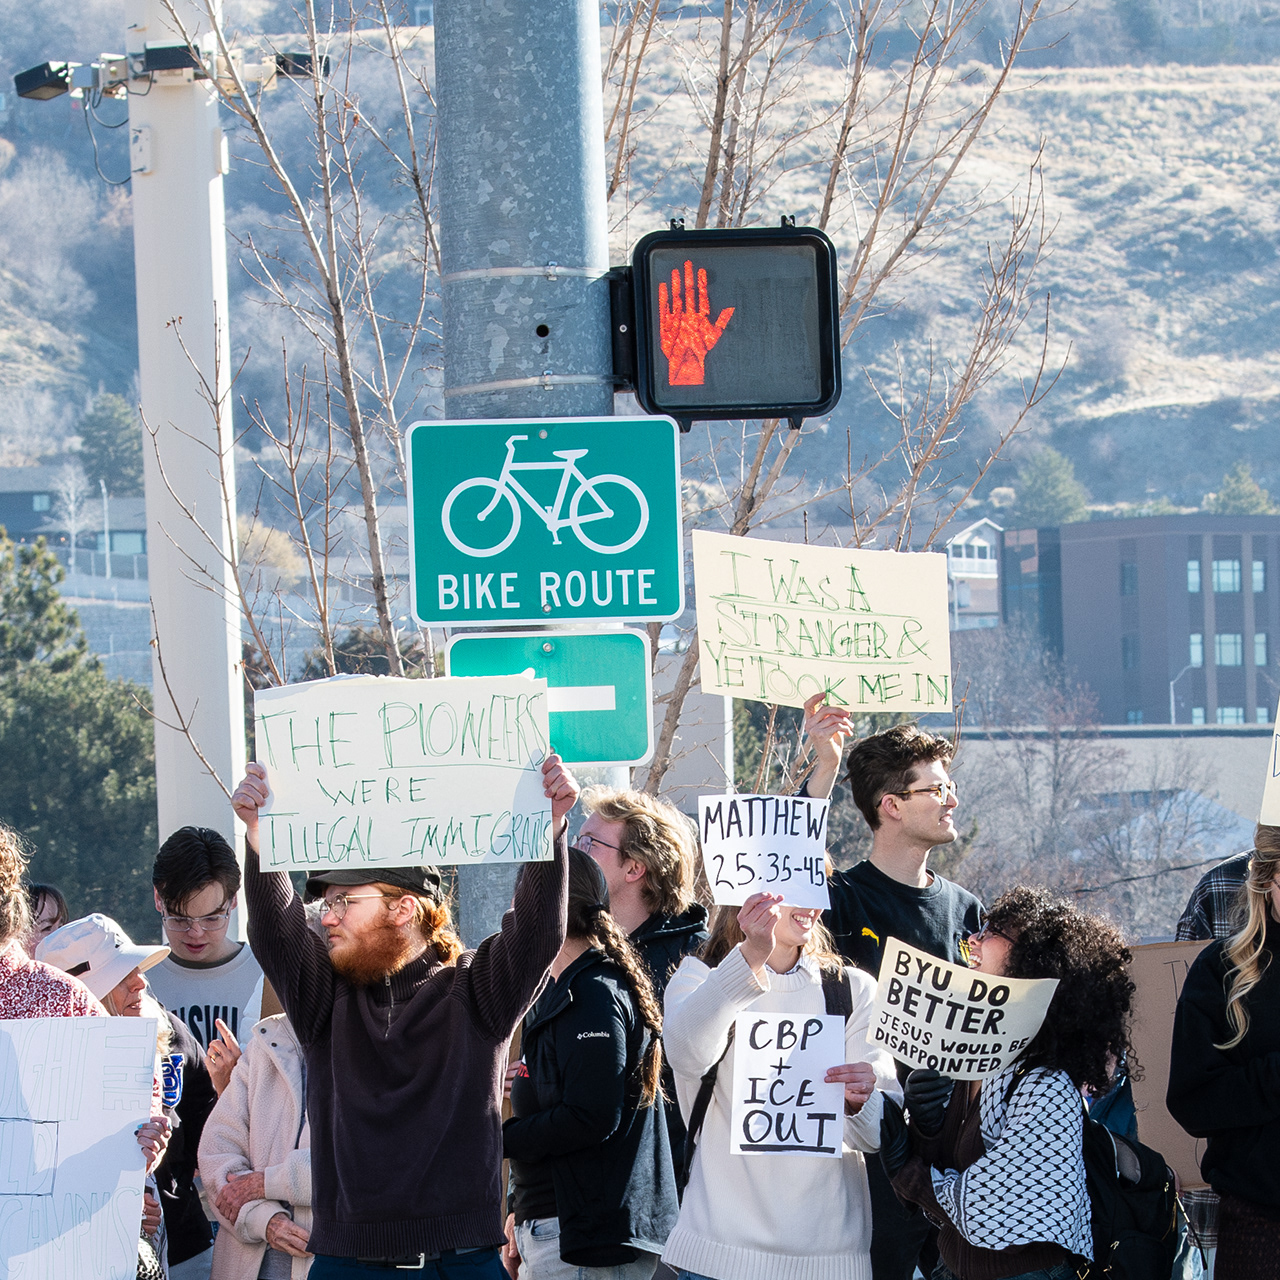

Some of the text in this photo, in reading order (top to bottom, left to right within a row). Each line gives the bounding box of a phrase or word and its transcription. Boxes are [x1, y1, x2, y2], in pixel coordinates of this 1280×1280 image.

[438, 569, 657, 610] BIKE ROUTE
[720, 551, 873, 613] I WAS A
[716, 601, 932, 660] STRANGER &
[750, 656, 949, 706] TOOK ME IN
[254, 692, 548, 771] THE PIONEERS
[316, 776, 436, 806] WERE
[258, 810, 552, 866] ILLEGAL IMMIGRANTS
[704, 796, 827, 844] MATTHEW
[712, 852, 824, 889] 25:35-45
[894, 950, 954, 998] BYU,
[970, 979, 1011, 1007] DO
[886, 979, 1007, 1036] BETTER.
[749, 1018, 823, 1051] CBP
[874, 1027, 1002, 1074] DISAPPOINTED.
[880, 1011, 1030, 1056] JESUS WOULD BE
[770, 1057, 792, 1076] +
[744, 1077, 815, 1107] ICE
[741, 1110, 836, 1148] OUT
